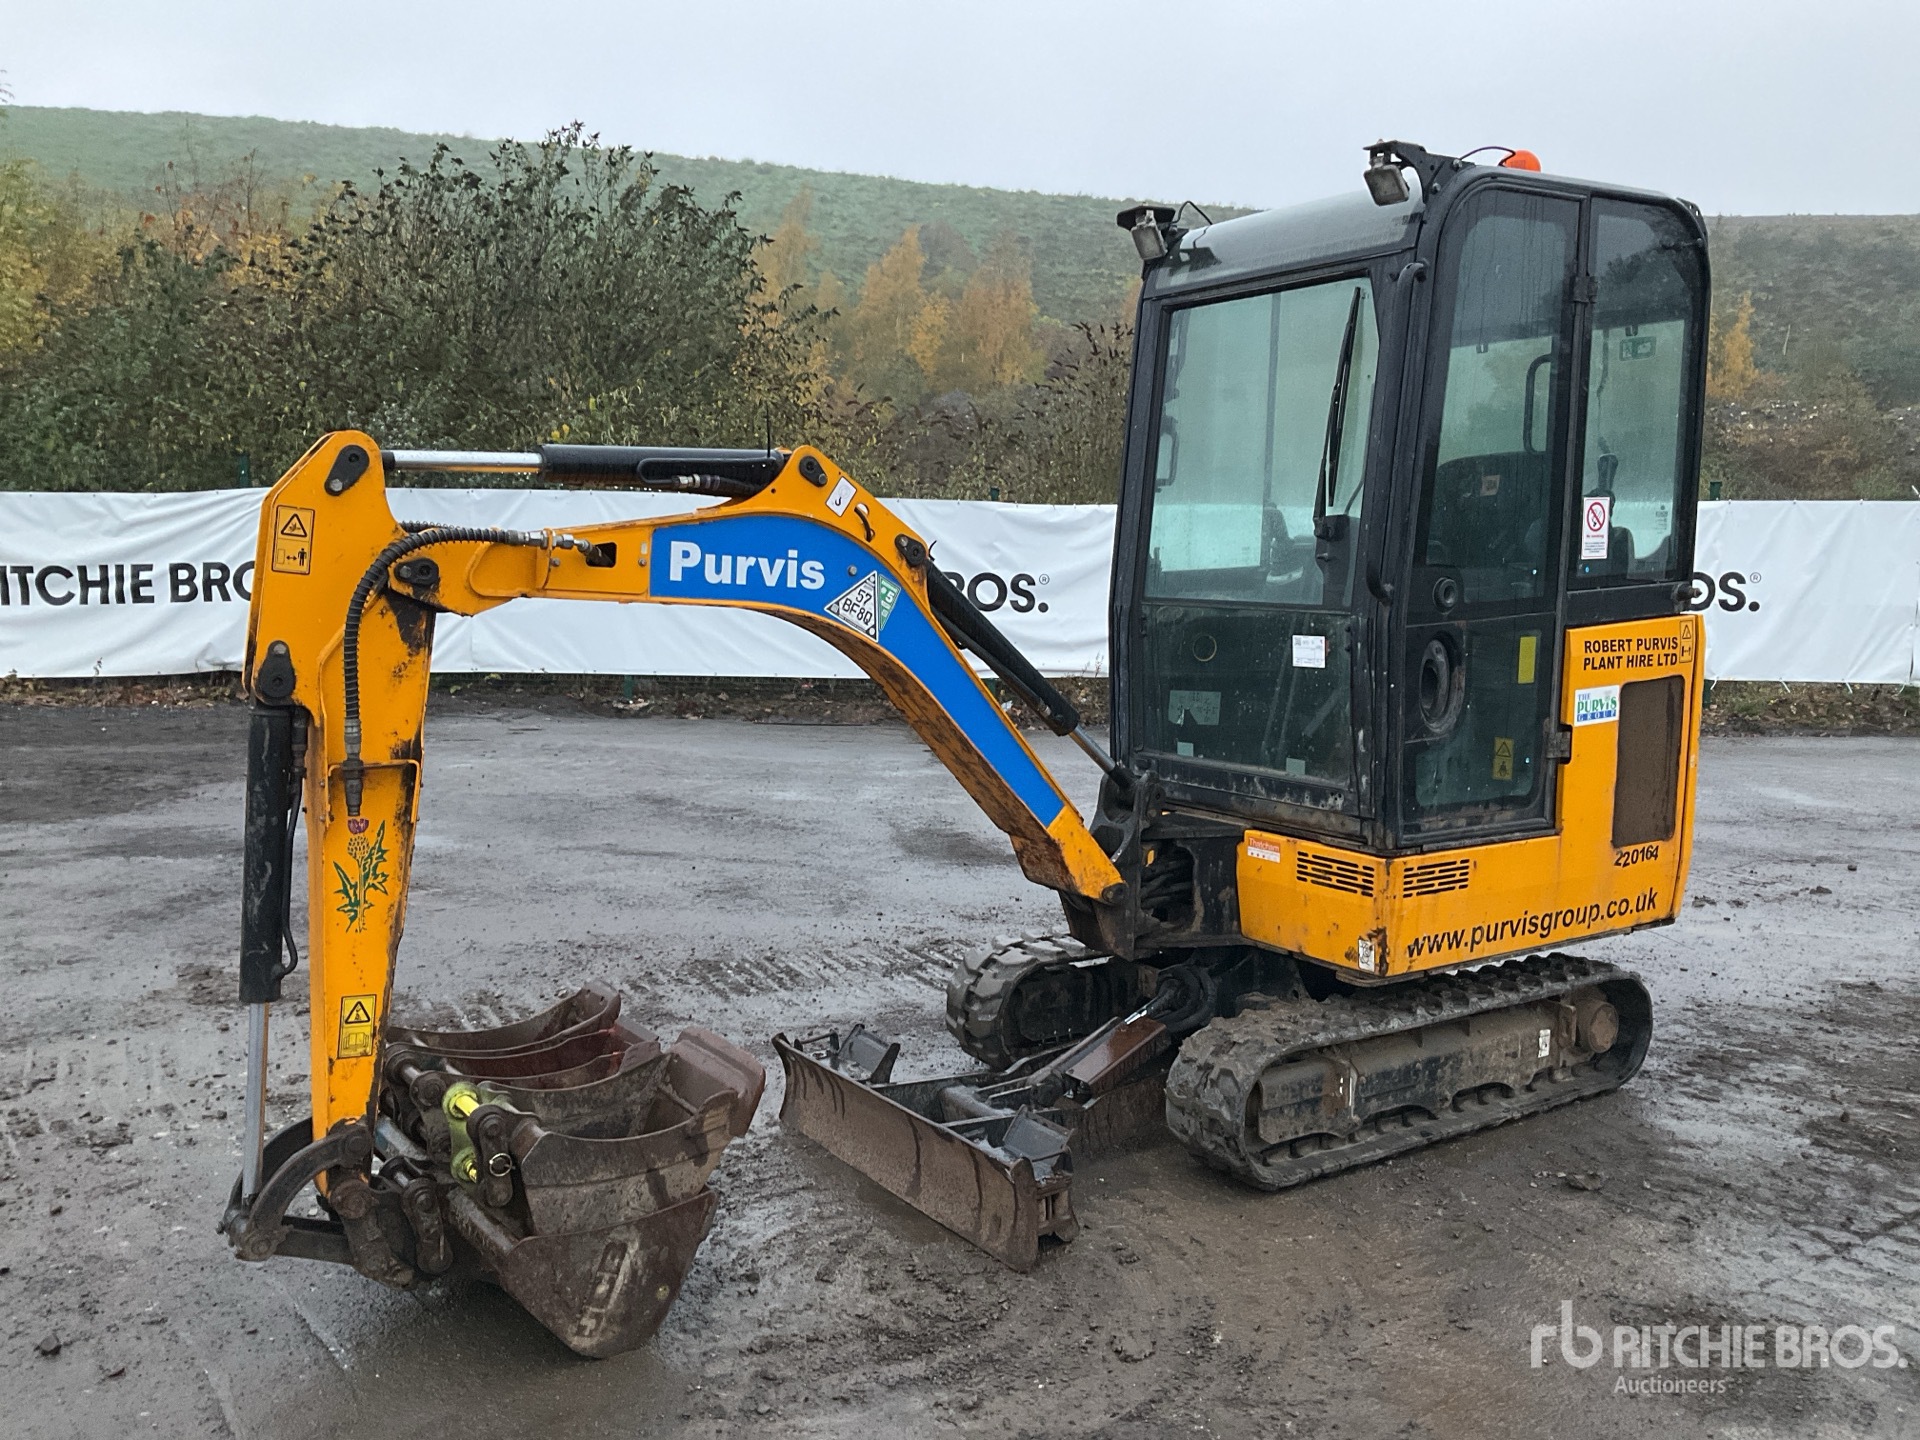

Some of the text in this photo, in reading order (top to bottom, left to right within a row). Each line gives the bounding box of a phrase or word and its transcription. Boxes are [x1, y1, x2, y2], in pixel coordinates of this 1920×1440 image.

[669, 540, 826, 590] Purvis
[856, 589, 872, 605] 57
[842, 597, 873, 625] BF8Q
[1584, 636, 1679, 654] ROBERT PURVIS
[1583, 653, 1678, 671] PLANT HIRE LTD
[1577, 697, 1617, 713] PURVIS
[1614, 845, 1659, 868] 220164
[1407, 886, 1658, 958] www.purvisgroup.co.uk
